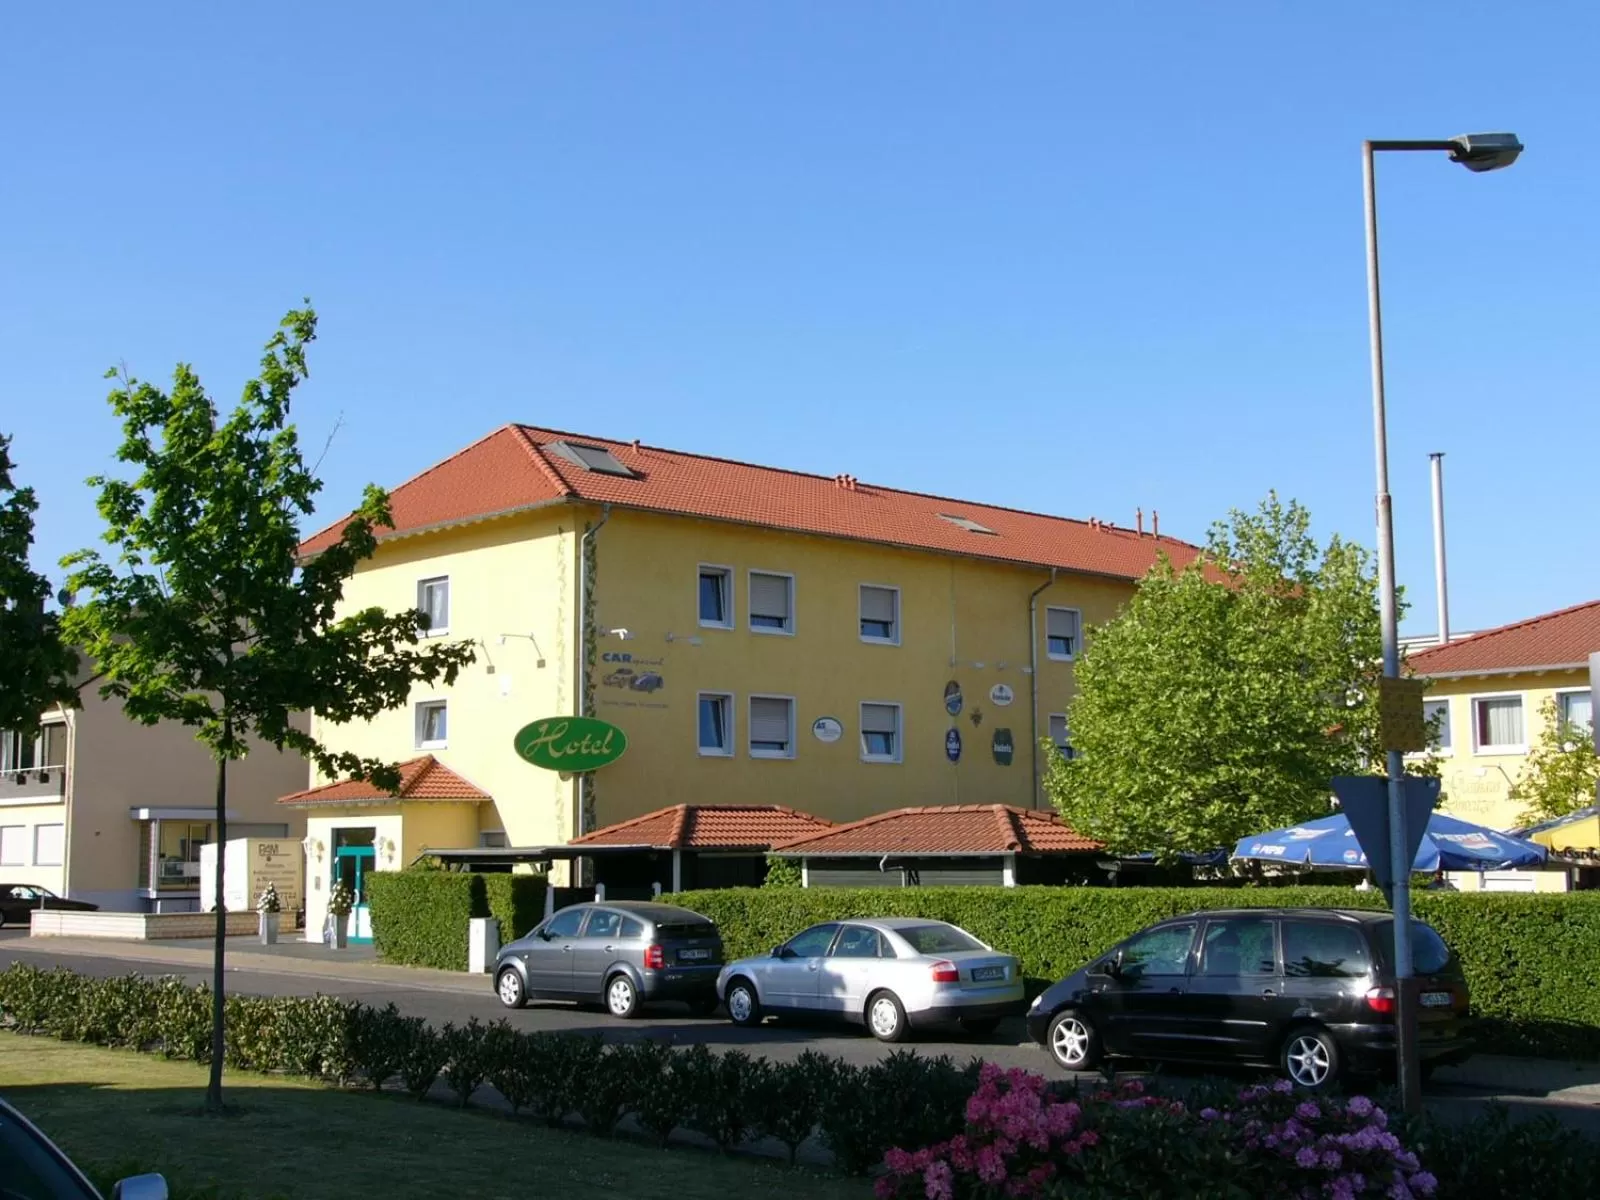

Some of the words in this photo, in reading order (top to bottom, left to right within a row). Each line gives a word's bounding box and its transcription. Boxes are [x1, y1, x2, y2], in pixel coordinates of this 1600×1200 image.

[602, 652, 632, 663] CAR
[523, 721, 613, 758] Hotel
[1259, 845, 1286, 855] PEPSI
